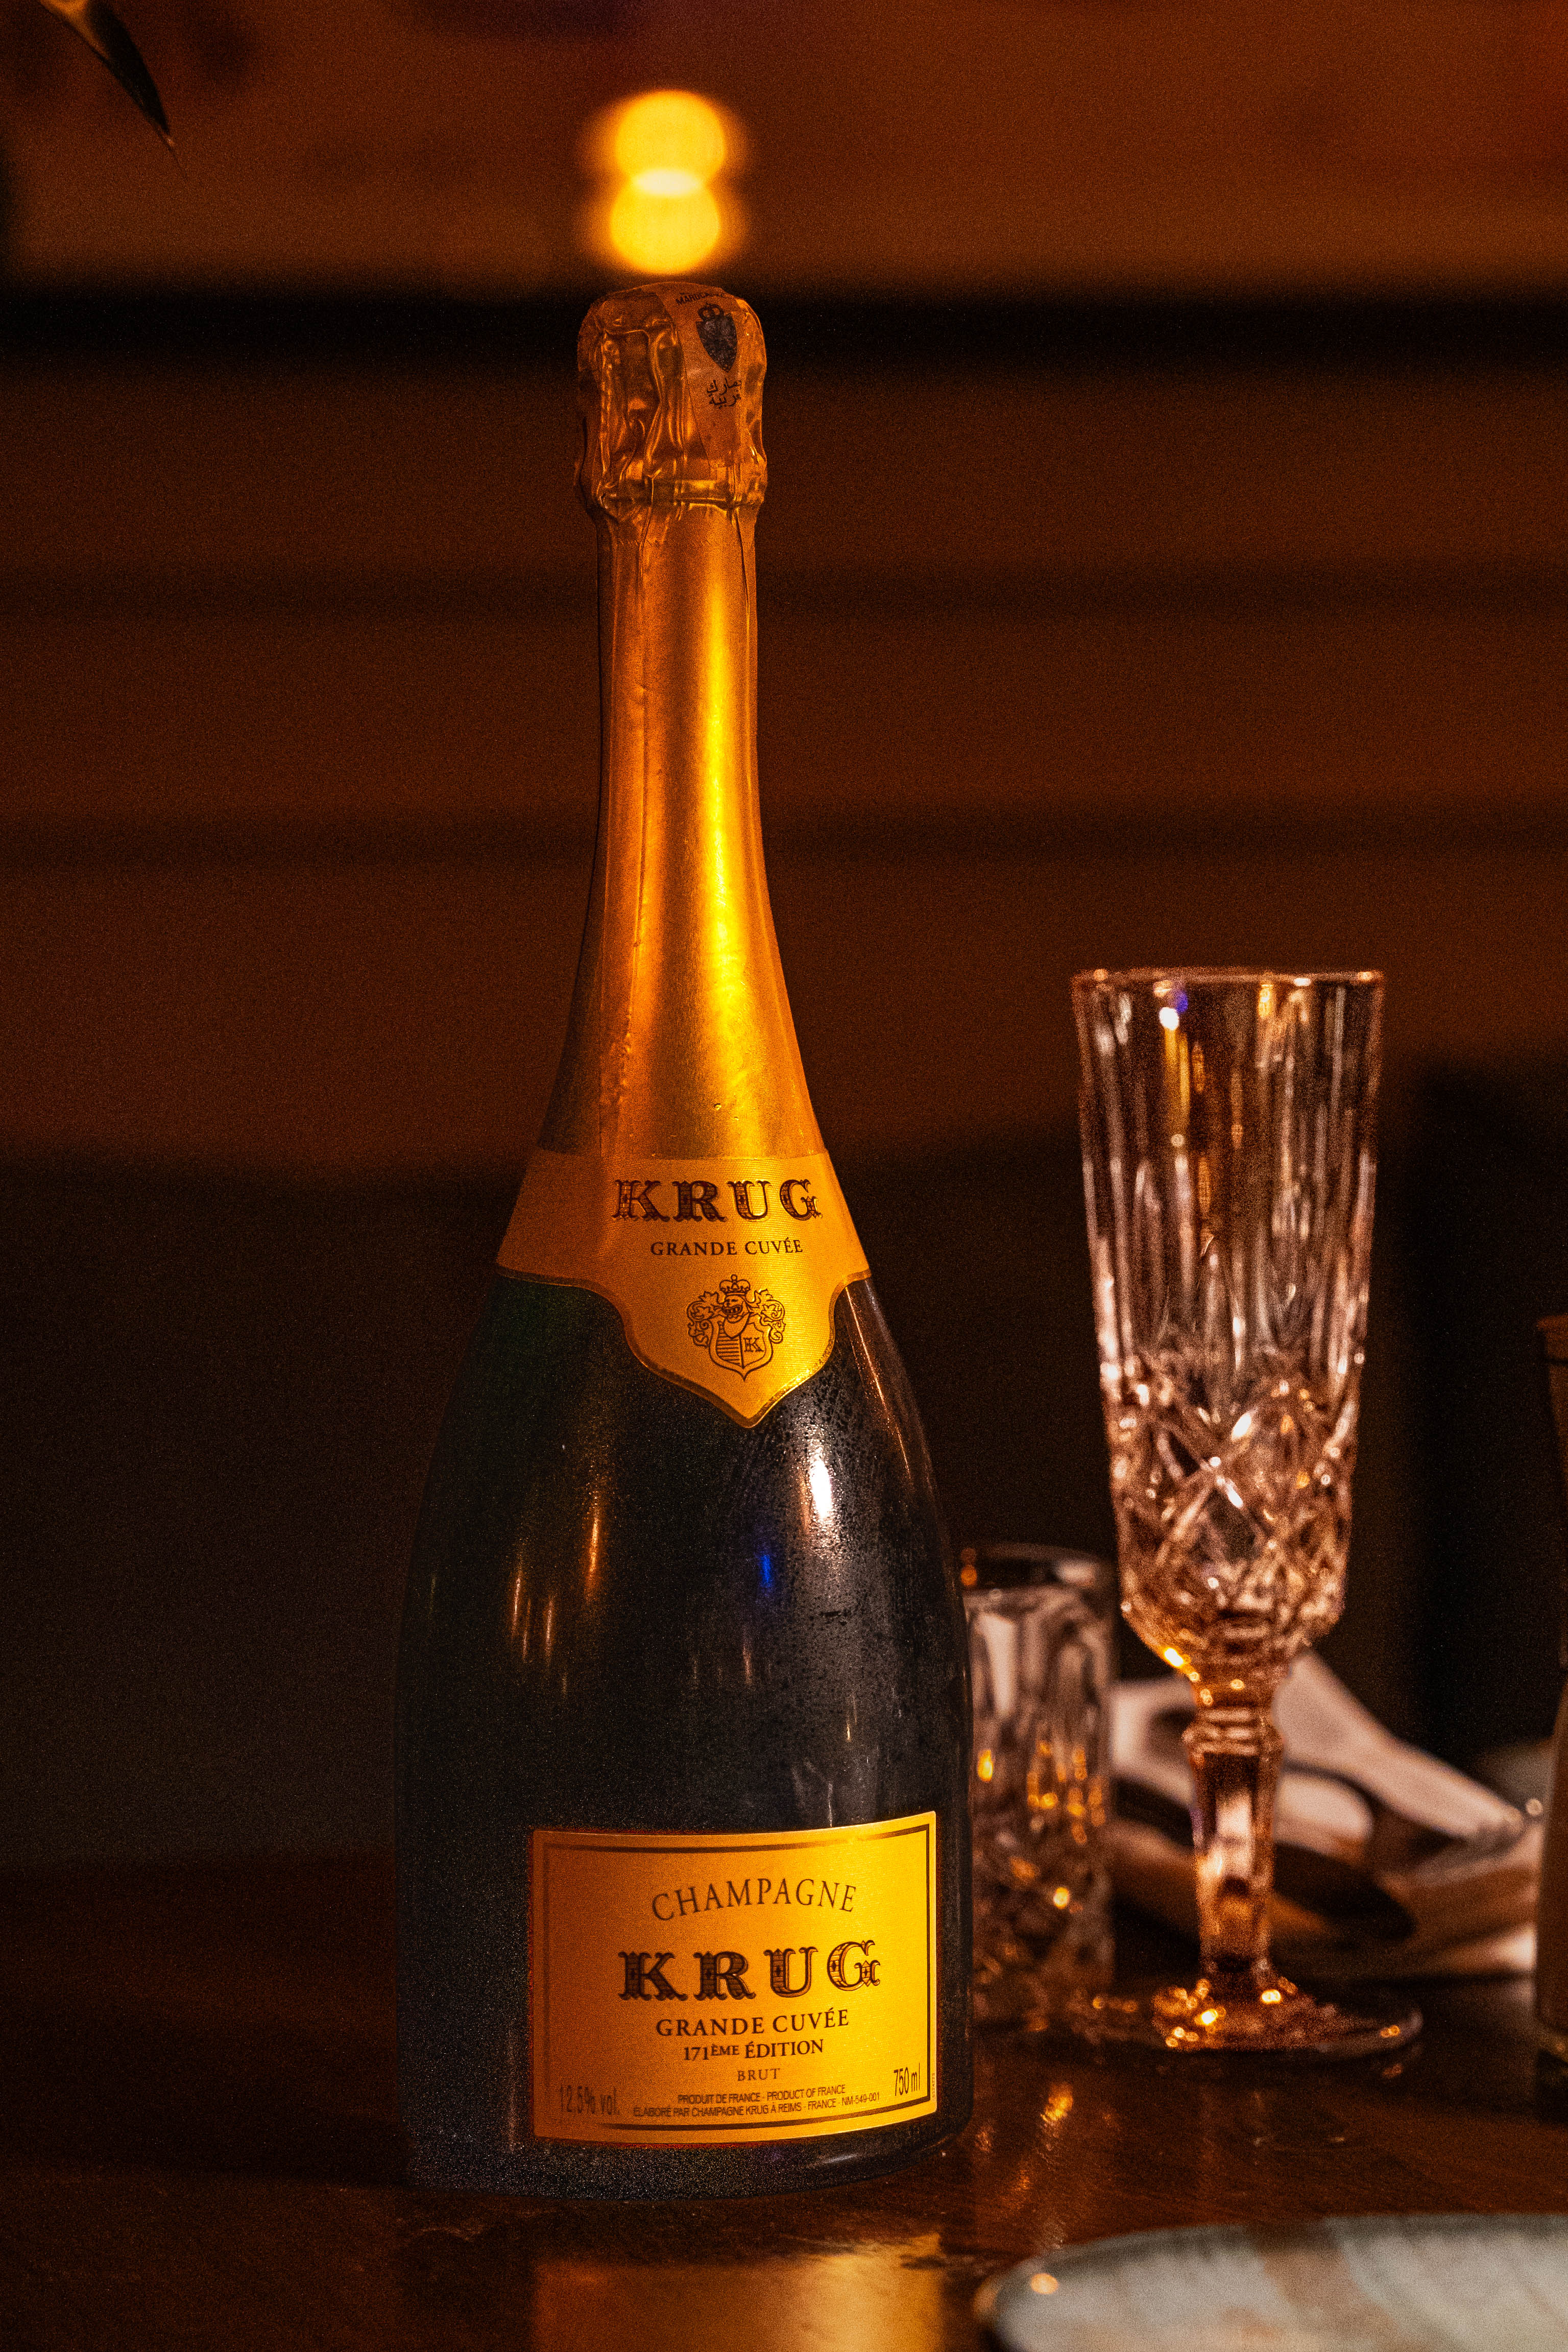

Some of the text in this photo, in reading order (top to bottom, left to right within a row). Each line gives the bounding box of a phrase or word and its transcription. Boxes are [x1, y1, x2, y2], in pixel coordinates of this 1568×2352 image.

[613, 1179, 823, 1221] KRUG
[651, 1237, 803, 1256] GRANDE CUVÉE
[652, 1878, 856, 1921] CHAMPAGNE
[618, 1939, 881, 2001] KRUG
[656, 2007, 849, 2036] GRANDE CUVÉE
[744, 2039, 824, 2059] ÉDITION
[737, 2068, 781, 2082] BRUT
[894, 2067, 909, 2096] 750
[673, 2107, 690, 2117] PAR
[691, 2106, 744, 2117] CHAMPAGNE
[745, 2105, 769, 2116] KRUG
[778, 2102, 802, 2113] REIMS
[808, 2098, 836, 2110] FRANCE
[842, 2092, 880, 2106] NM-549-001
[678, 2084, 846, 2104] PRODUIT DE FRANCE PRODUCT OF FRANCE
